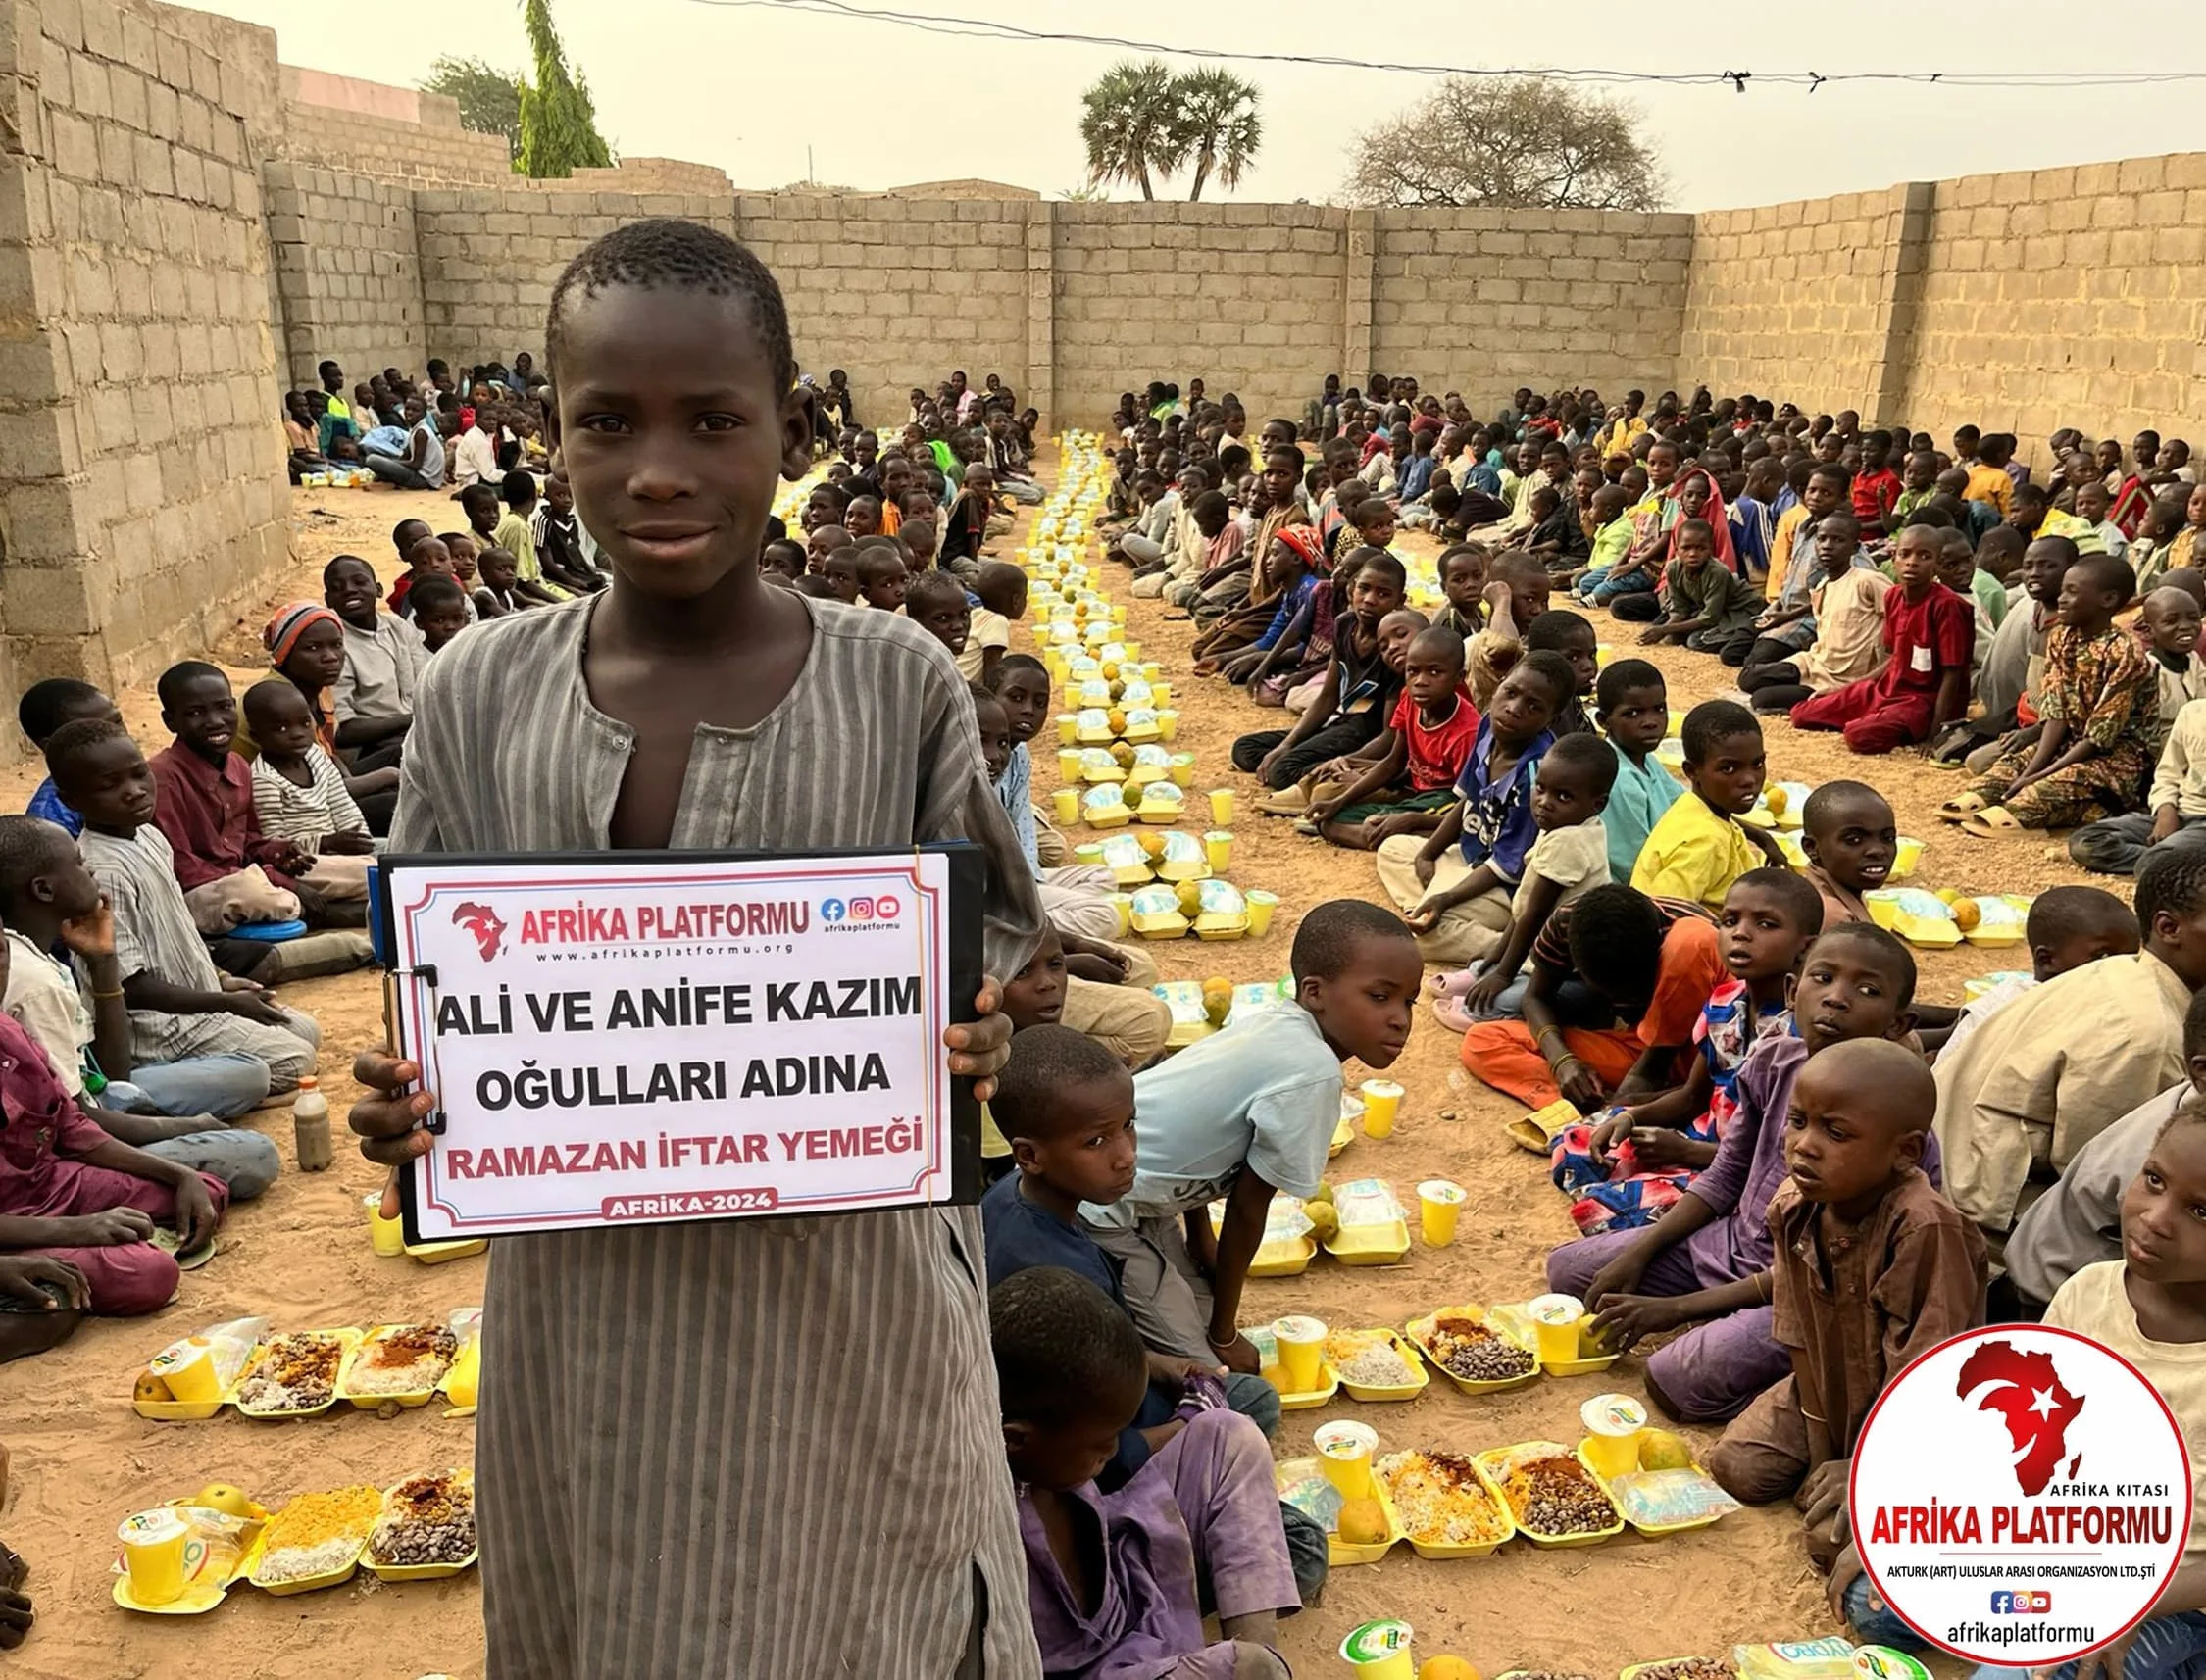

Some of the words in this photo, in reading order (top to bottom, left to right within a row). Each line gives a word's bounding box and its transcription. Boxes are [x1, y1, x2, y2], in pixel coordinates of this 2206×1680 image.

[521, 900, 627, 944] AFRİKA
[638, 901, 810, 941] PLATFORMU
[824, 921, 900, 934] afrikaplatformu
[536, 943, 793, 963] www.afrikaplatformu.org
[436, 983, 512, 1037] ALİ
[525, 992, 593, 1034] VE
[606, 977, 752, 1030] ANİFE
[766, 976, 922, 1022] KAZIM
[476, 1060, 727, 1112] OĞULLARI
[740, 1053, 890, 1100] ADINA
[447, 1140, 646, 1180] RAMAZAN
[659, 1131, 768, 1168] İFTAR
[777, 1116, 923, 1161] YEMEĞİ
[609, 1193, 773, 1217] AFRİKA-2024
